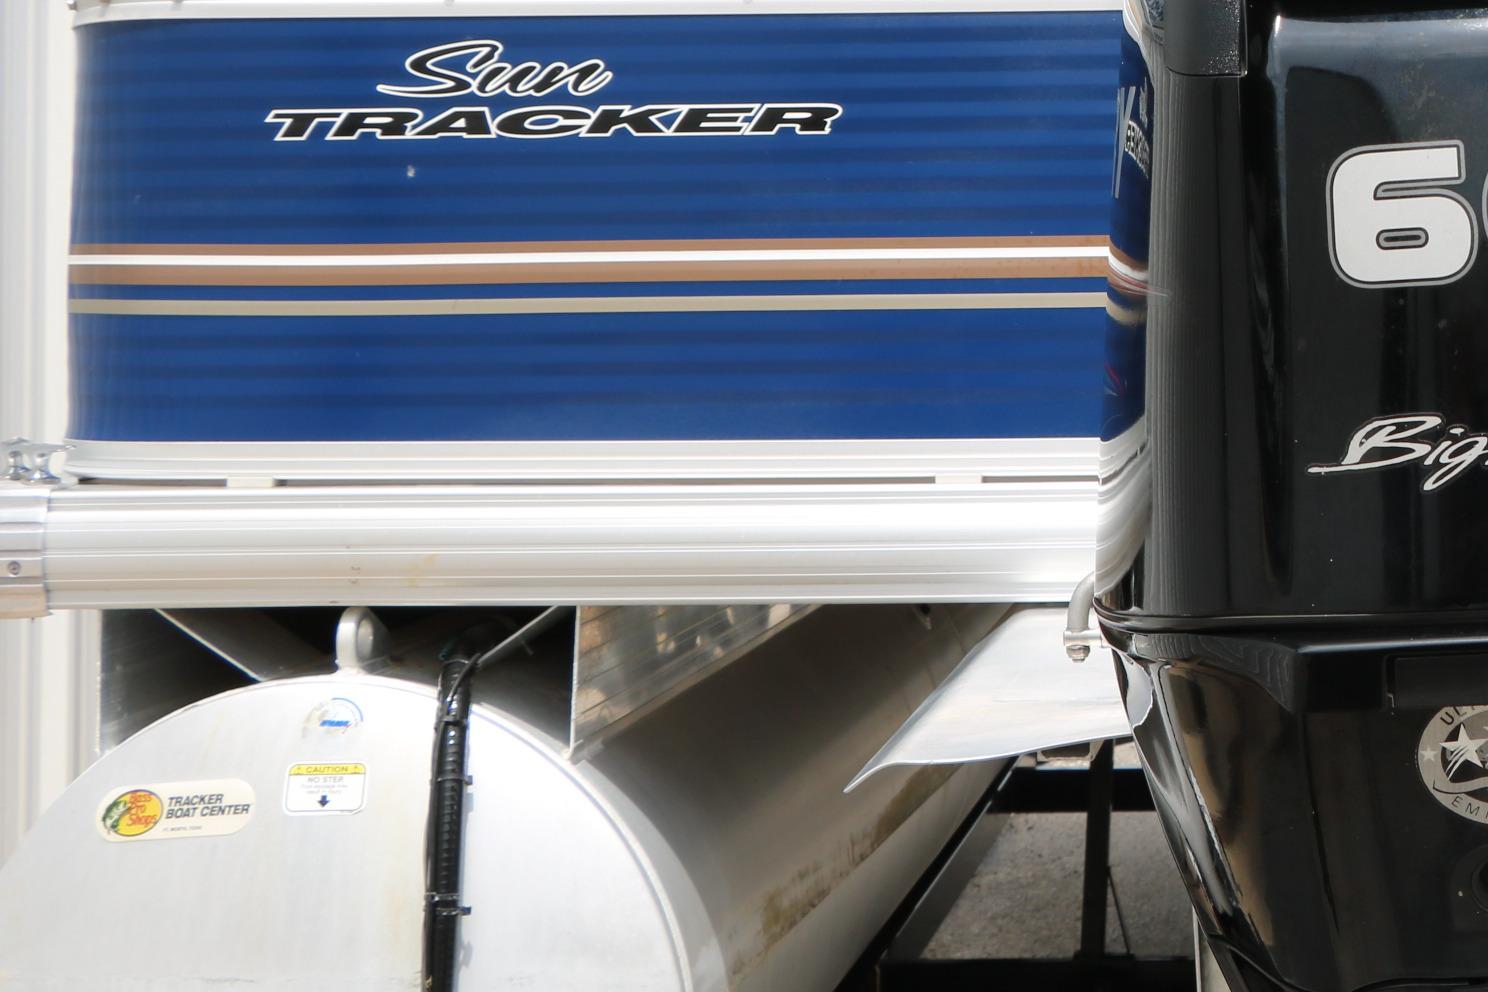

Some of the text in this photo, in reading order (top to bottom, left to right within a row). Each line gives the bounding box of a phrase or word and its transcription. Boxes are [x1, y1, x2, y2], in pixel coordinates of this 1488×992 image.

[376, 39, 614, 97] Sun
[264, 103, 843, 141] TRACKER
[305, 766, 349, 774] CAUTION
[167, 793, 224, 807] TRACKER
[165, 804, 251, 819] BOAT CENTER
